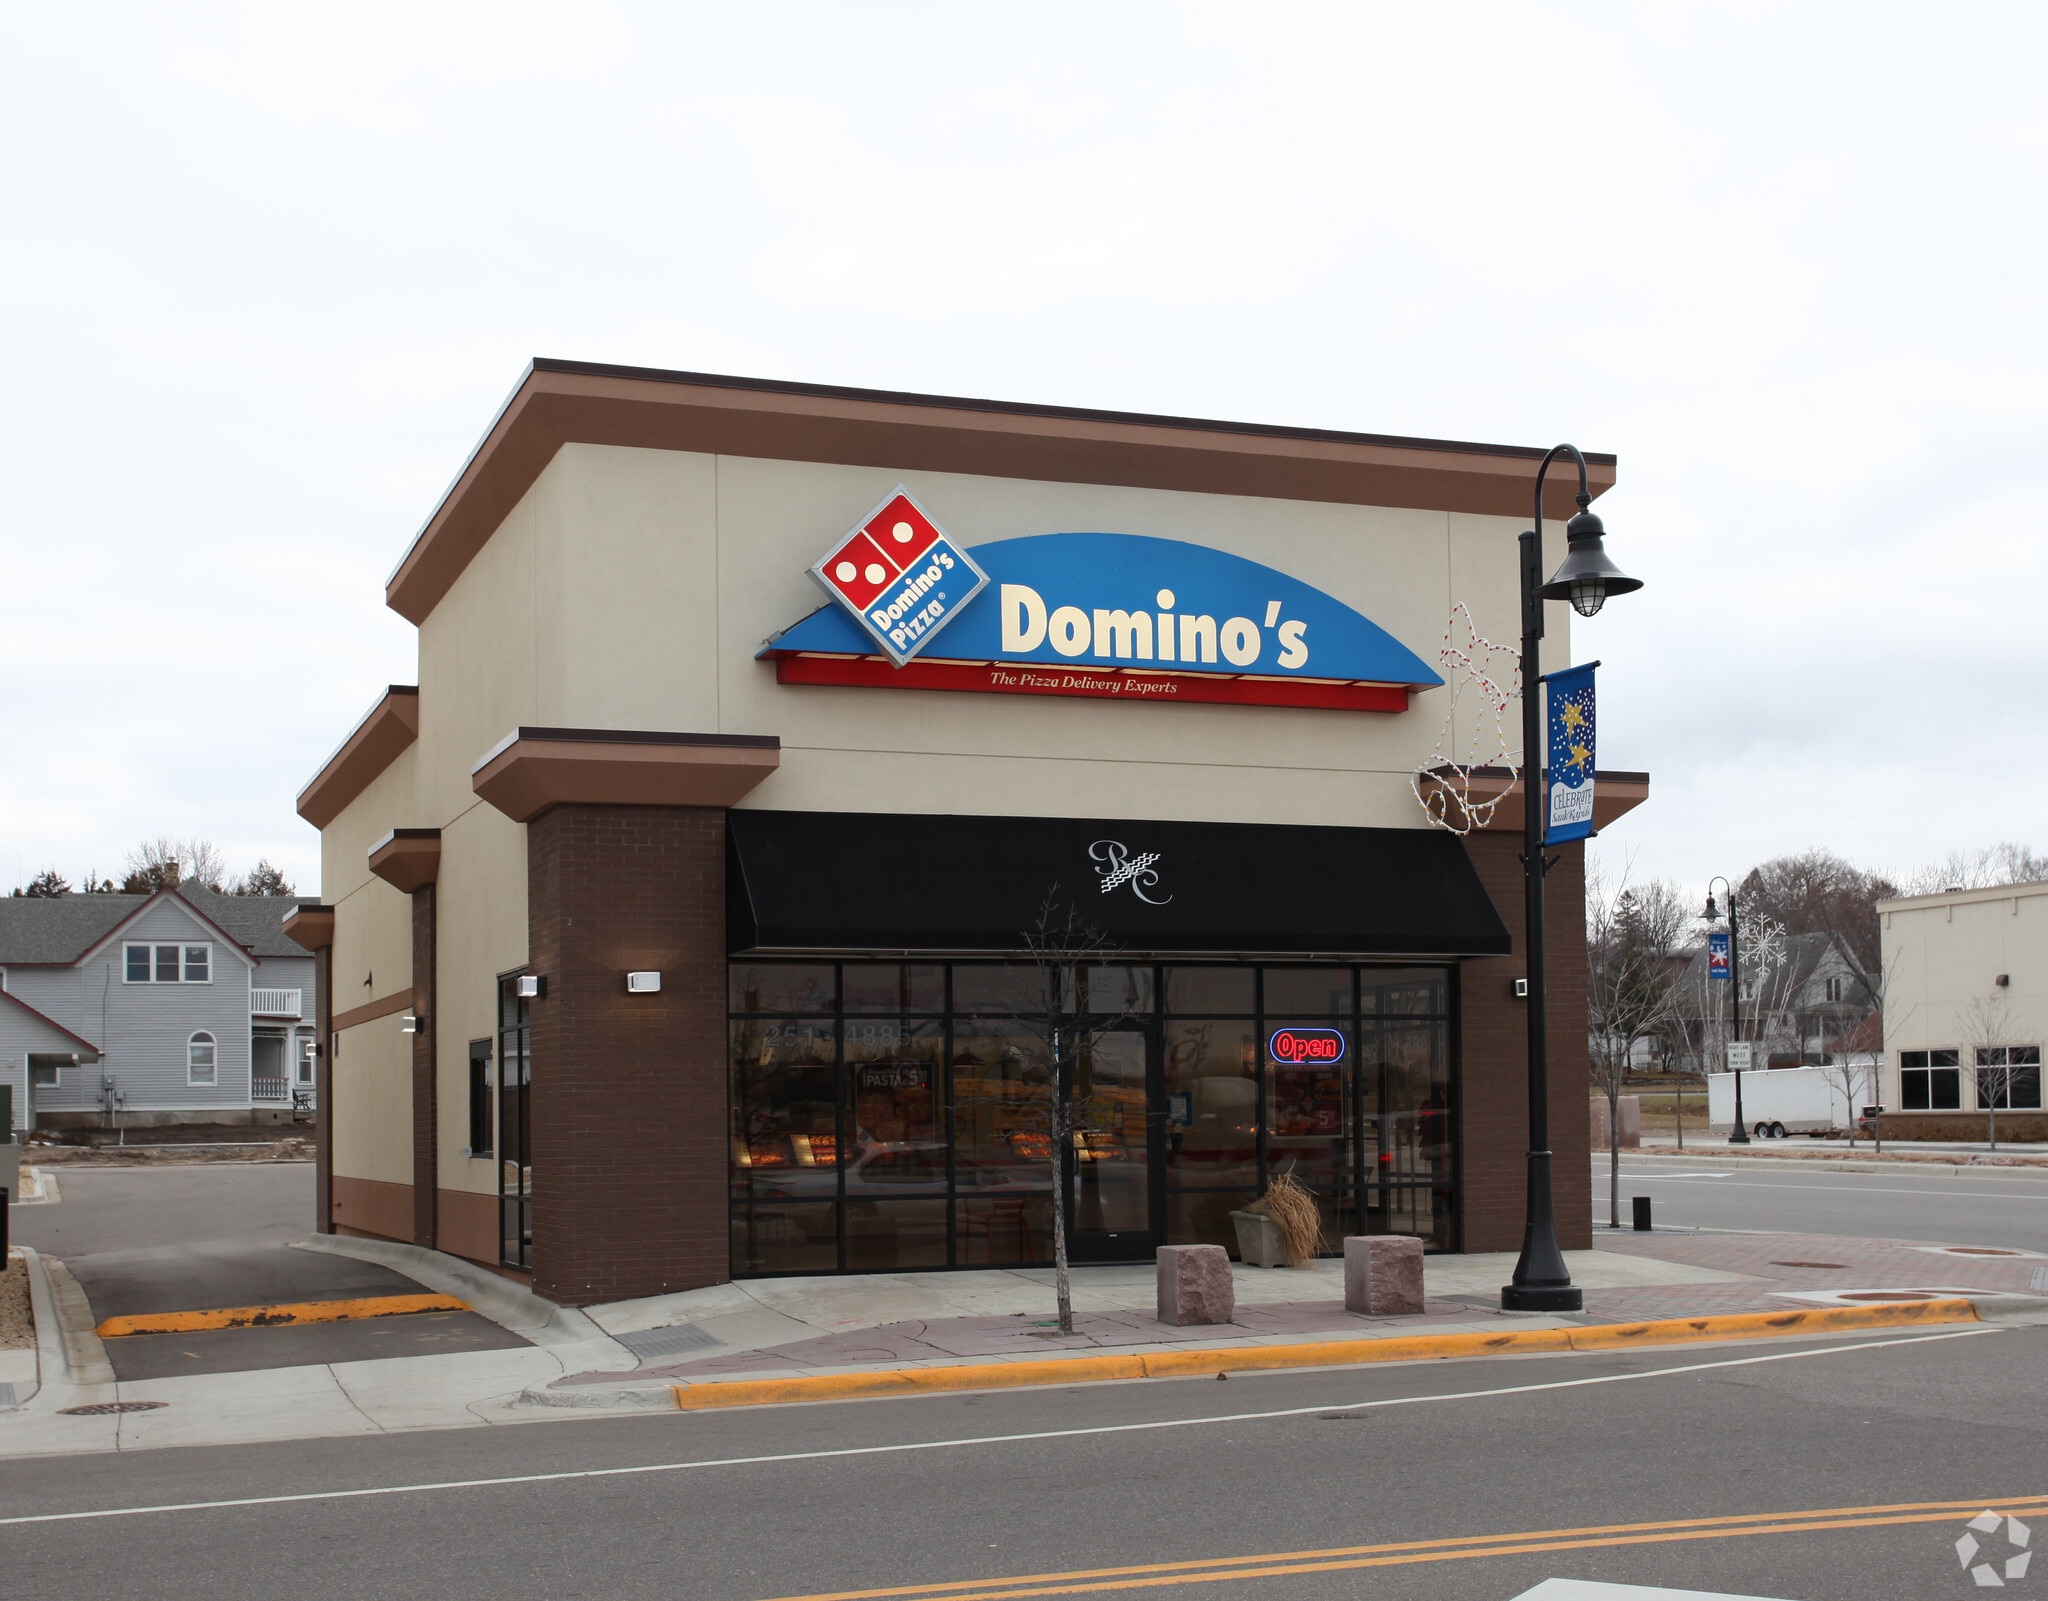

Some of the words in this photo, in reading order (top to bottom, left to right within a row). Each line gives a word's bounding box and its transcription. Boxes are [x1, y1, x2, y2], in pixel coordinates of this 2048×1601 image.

[871, 553, 954, 632] Domino's
[1000, 584, 1309, 669] Domino's
[990, 672, 1017, 685] The
[1020, 674, 1058, 688] Pizza
[1062, 676, 1121, 693] Delivery
[1124, 679, 1177, 695] Experts
[1277, 1033, 1336, 1062] Open
[867, 1074, 902, 1087] PASTA
